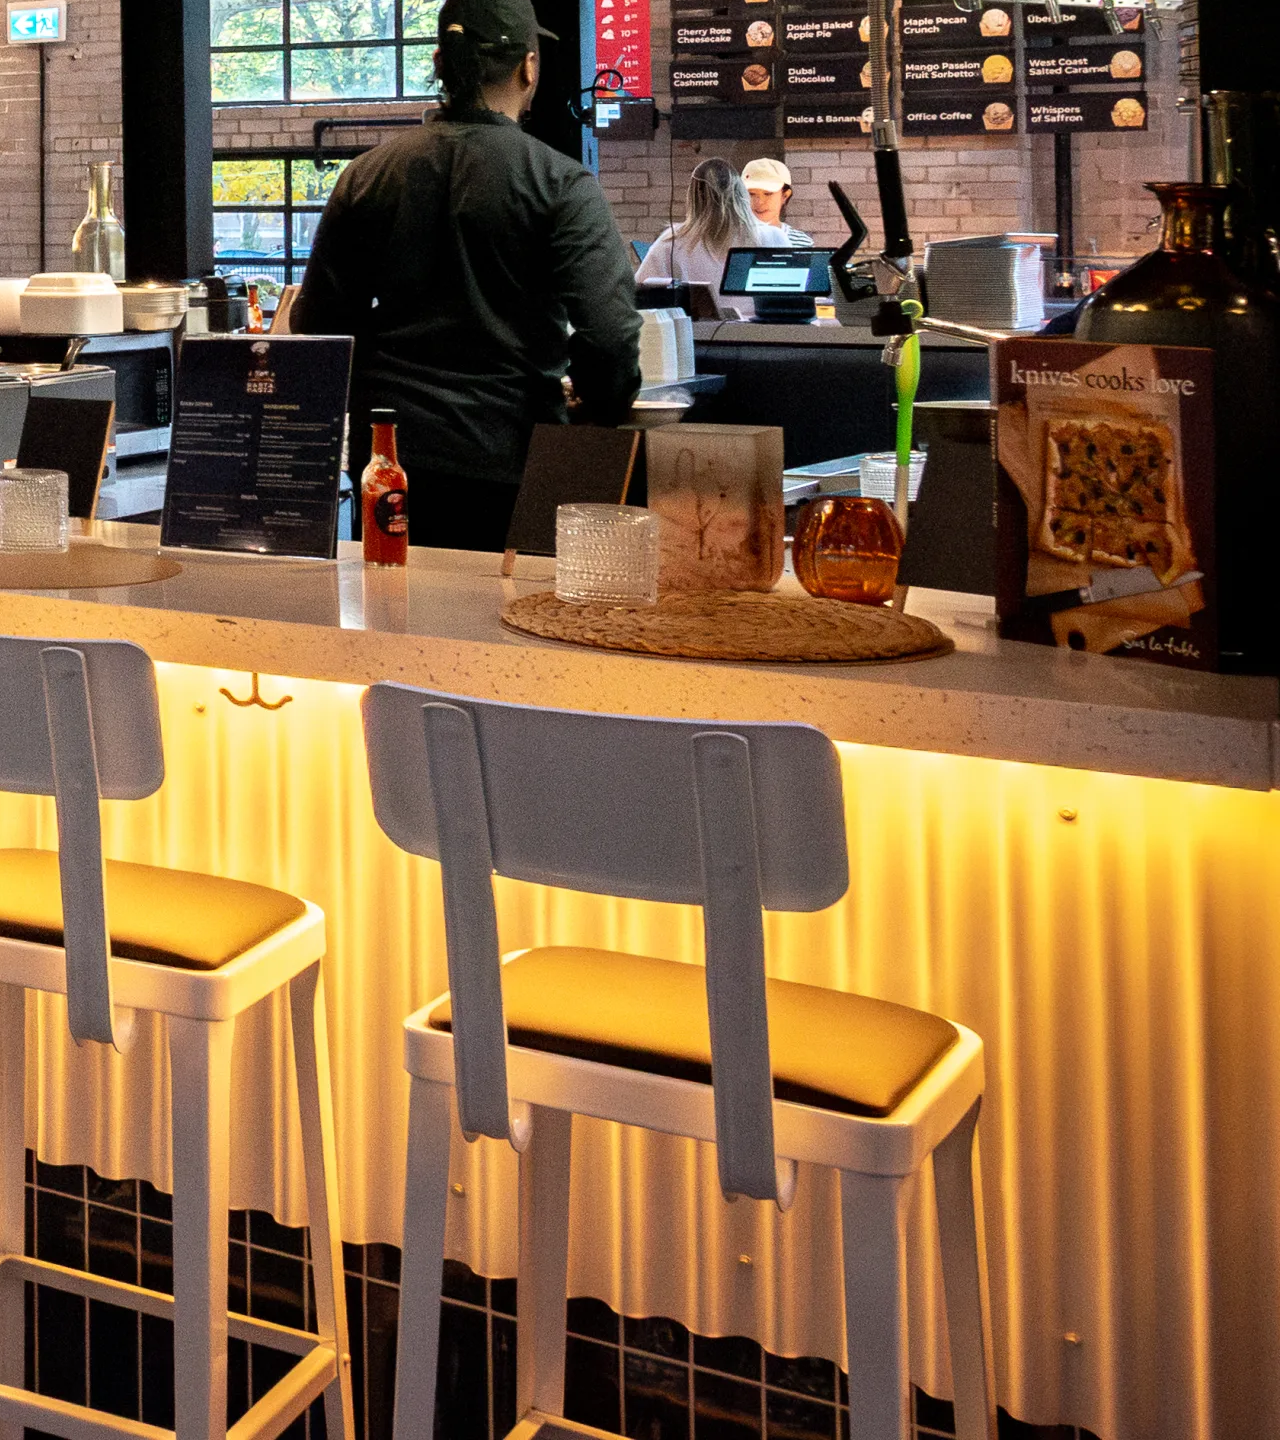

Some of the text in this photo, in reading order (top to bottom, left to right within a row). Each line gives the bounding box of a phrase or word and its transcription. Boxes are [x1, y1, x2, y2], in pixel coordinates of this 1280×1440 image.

[786, 20, 854, 32] Double Baked
[903, 16, 967, 27] Maple Pecan
[677, 27, 732, 37] Cherry Rose
[786, 29, 832, 41] Apple Pie
[903, 25, 940, 35] Crunch
[677, 35, 732, 44] Cheesecake
[905, 61, 981, 72] Mango Passion
[1028, 57, 1089, 67] West Coast
[673, 70, 719, 80] Chocolate
[788, 66, 816, 75] Dubai
[905, 70, 975, 80] Fruit Sorbetto
[1028, 65, 1109, 76] Salted Caramel
[673, 79, 720, 87] Cashmere
[788, 75, 836, 84] Chocolate
[1030, 105, 1081, 115] Whispers
[787, 114, 862, 124] Dulce & Banana
[907, 112, 973, 121] Office Coffee
[1030, 114, 1083, 123] of Saffron
[1009, 360, 1198, 396] knives cooks love
